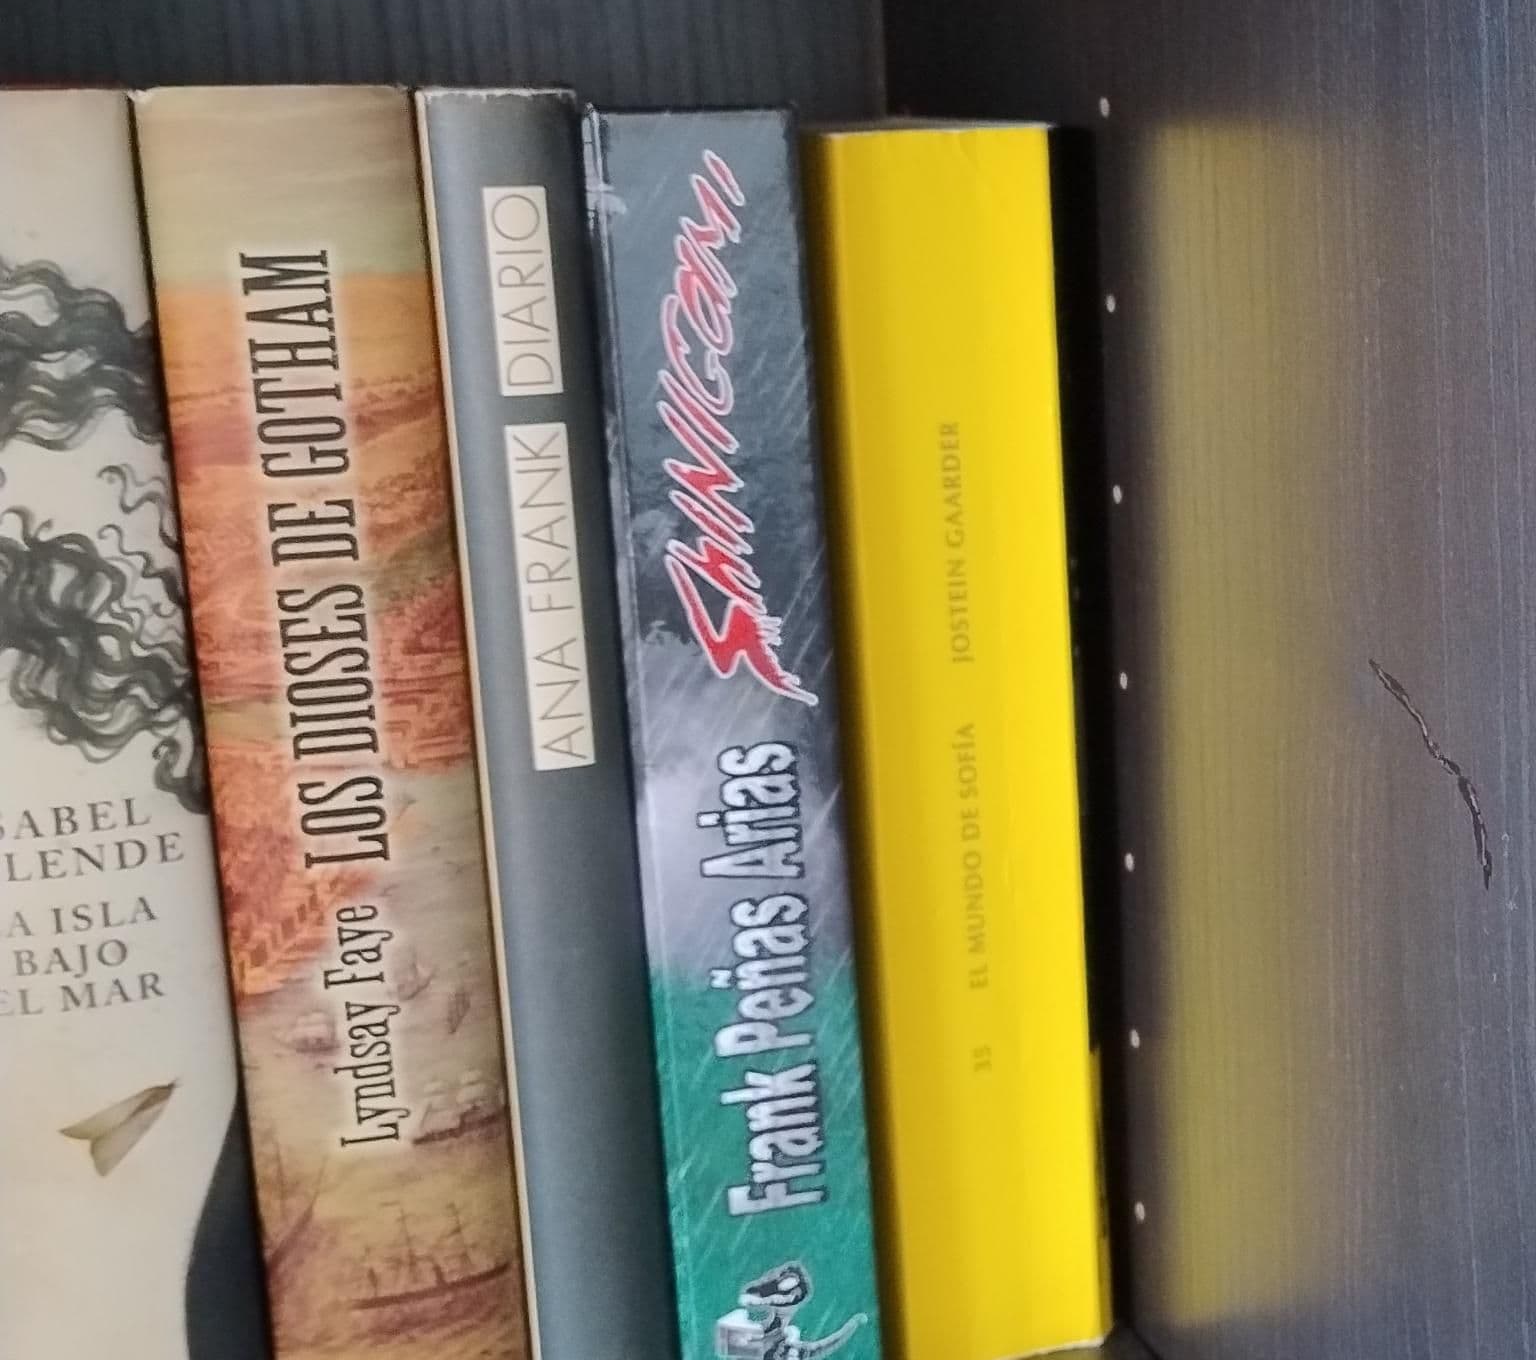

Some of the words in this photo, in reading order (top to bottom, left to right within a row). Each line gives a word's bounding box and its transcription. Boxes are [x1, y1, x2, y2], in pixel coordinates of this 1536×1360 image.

[491, 193, 556, 388] DIARIO
[238, 249, 349, 478] GOTHAM
[268, 499, 359, 567] DE
[511, 431, 575, 613] FRANK
[938, 421, 964, 549] GAARDER
[946, 558, 976, 665] JOSTEIN
[277, 582, 381, 761] DIOSES
[533, 637, 588, 760] ANA
[696, 740, 807, 879] Arias
[952, 722, 979, 801] SOFÍA
[298, 773, 390, 869] LOS
[960, 807, 981, 841] DE
[50, 896, 158, 935] ISLA
[323, 904, 395, 989] Faye
[963, 849, 987, 954] MUNDO
[13, 939, 128, 979] BAJO
[60, 972, 166, 1013] MAR
[710, 892, 813, 1057] Peñas
[968, 963, 989, 991] EL
[334, 999, 410, 1147] Lyndsay
[720, 1060, 827, 1217] Frank
